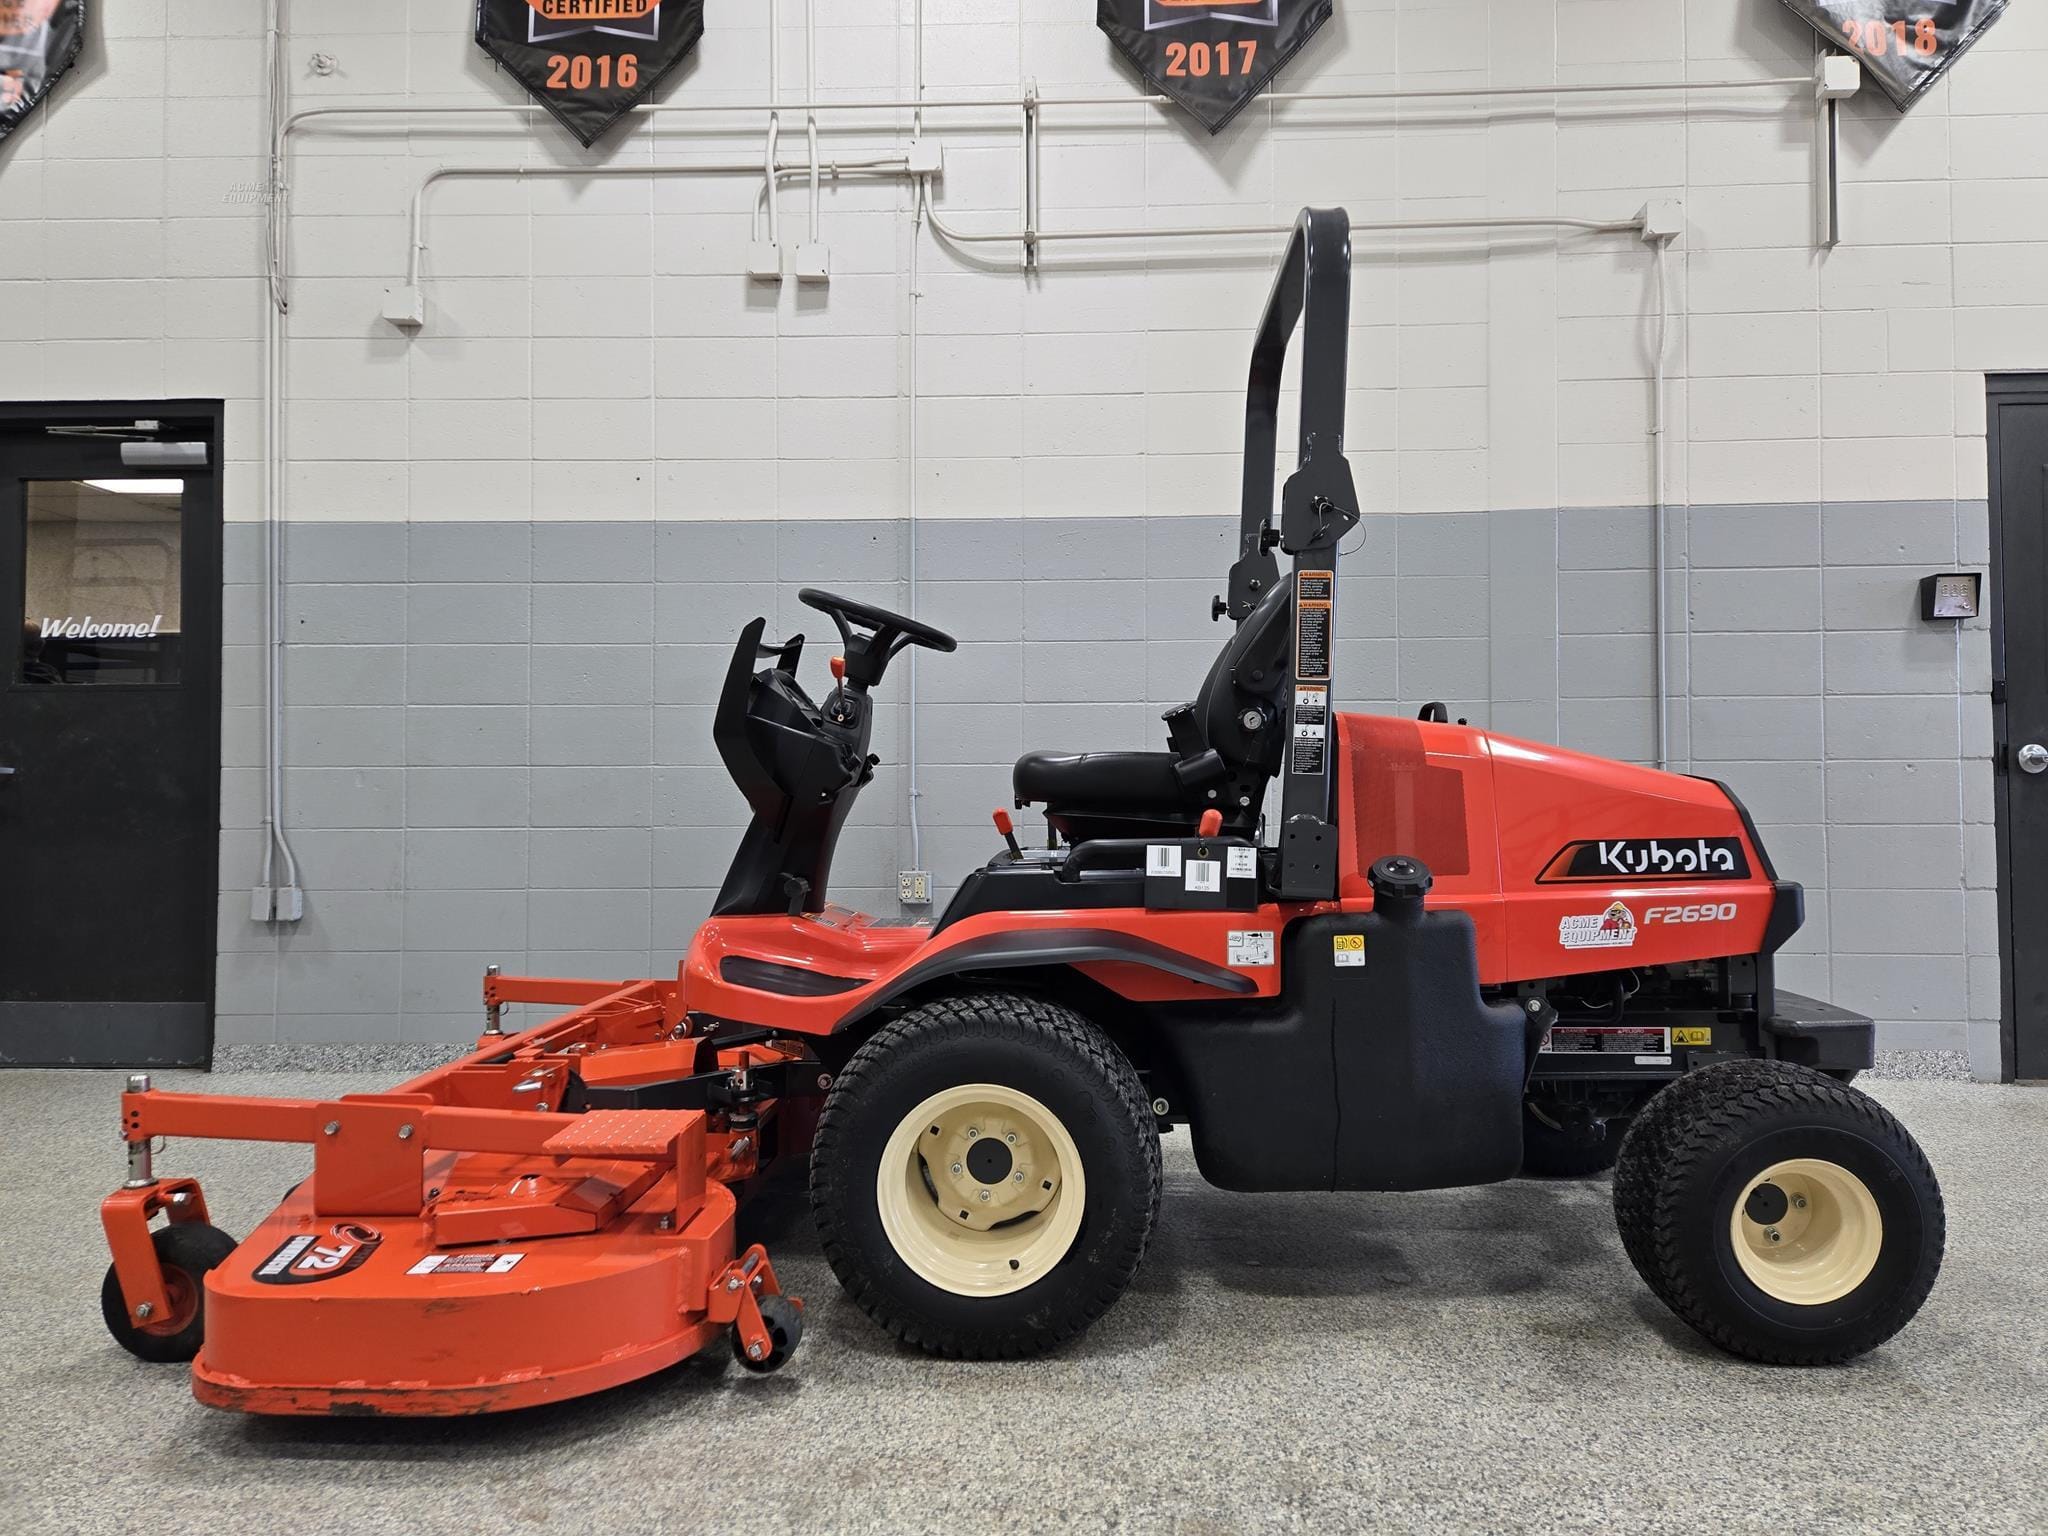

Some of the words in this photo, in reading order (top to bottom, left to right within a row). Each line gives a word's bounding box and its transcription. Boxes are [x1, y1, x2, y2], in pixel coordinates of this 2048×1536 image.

[542, 0, 647, 14] CERTIFIED
[1842, 18, 1937, 57] 2018
[1165, 40, 1257, 77] 2017
[546, 54, 638, 90] 2016
[40, 615, 163, 638] Welcome!
[1599, 839, 1735, 873] Kubota
[1561, 916, 1598, 929] ACME
[1644, 903, 1737, 925] F2690
[1561, 928, 1636, 943] EQUIPMENT
[297, 1244, 354, 1269] 72
